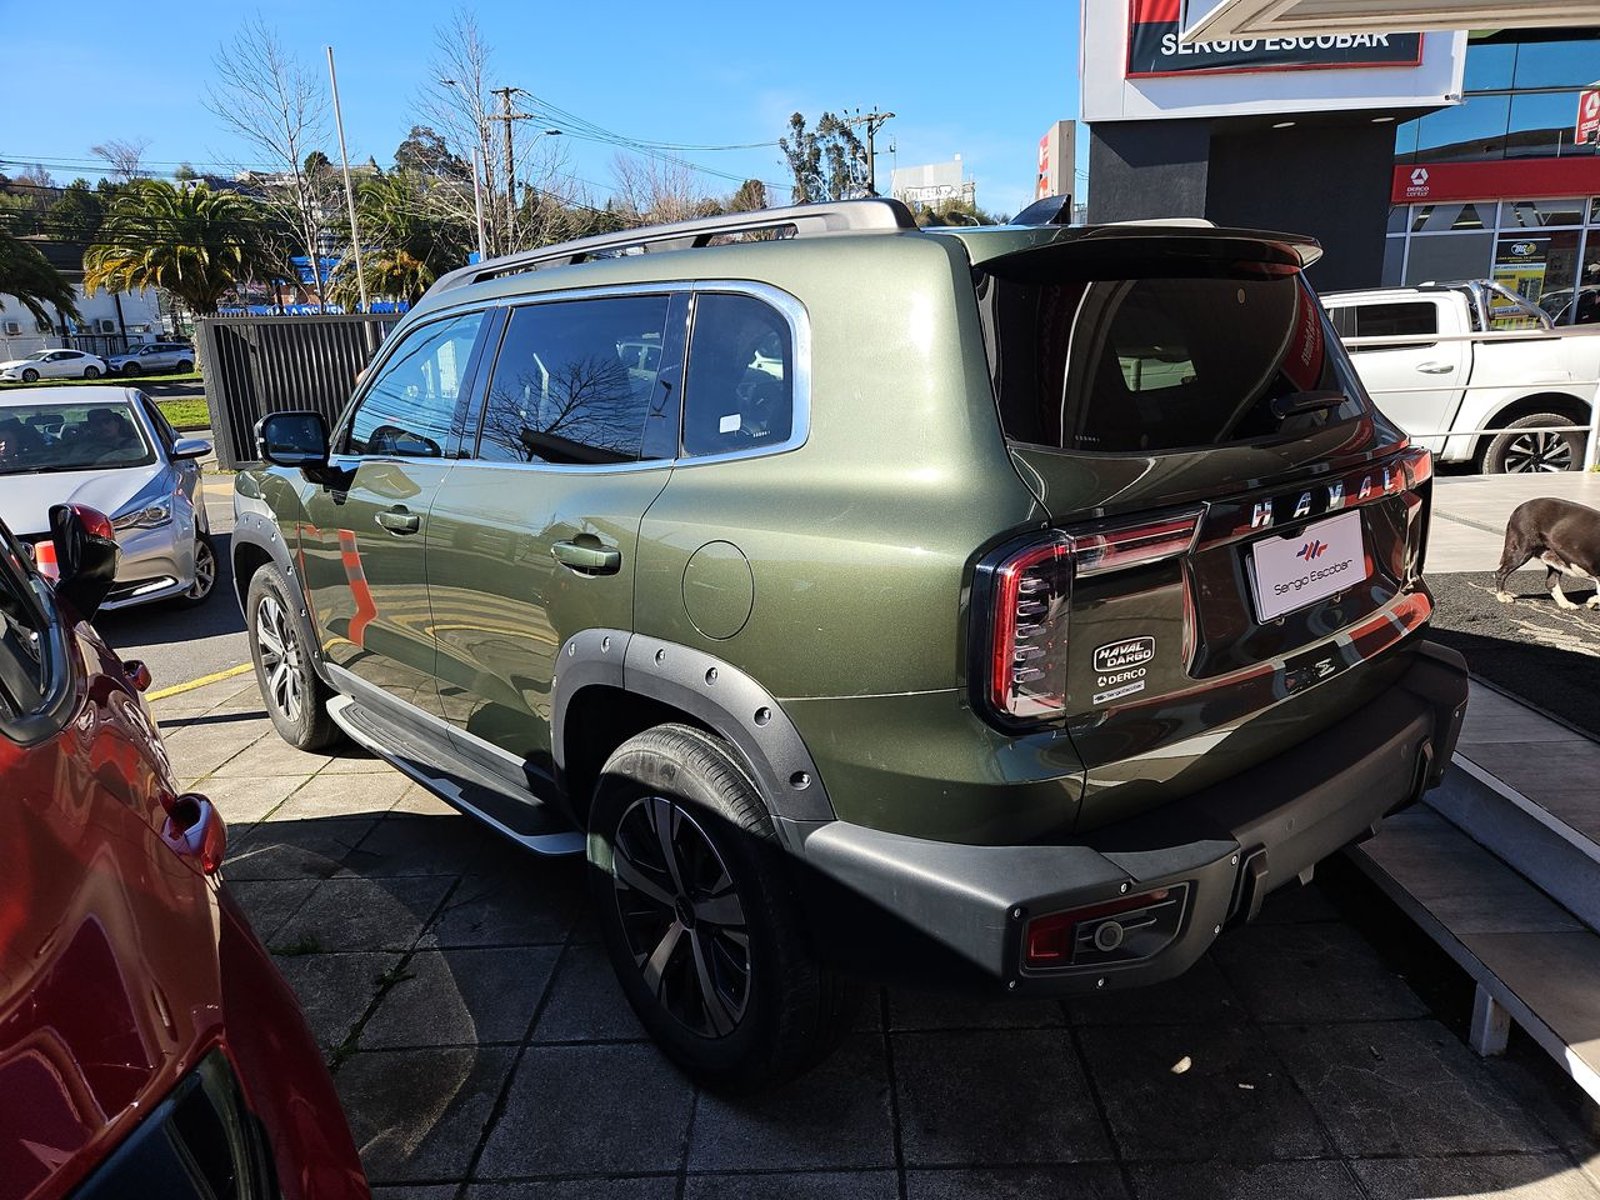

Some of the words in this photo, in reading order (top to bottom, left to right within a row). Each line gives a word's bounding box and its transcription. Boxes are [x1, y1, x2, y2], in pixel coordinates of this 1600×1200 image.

[1265, 33, 1389, 51] ESCOBAR
[1251, 469, 1394, 528] HAVAL
[1310, 559, 1354, 582] Escobar
[1099, 643, 1144, 659] HAVAL
[1107, 650, 1151, 666] DARGO
[1109, 668, 1146, 684] DERCO
